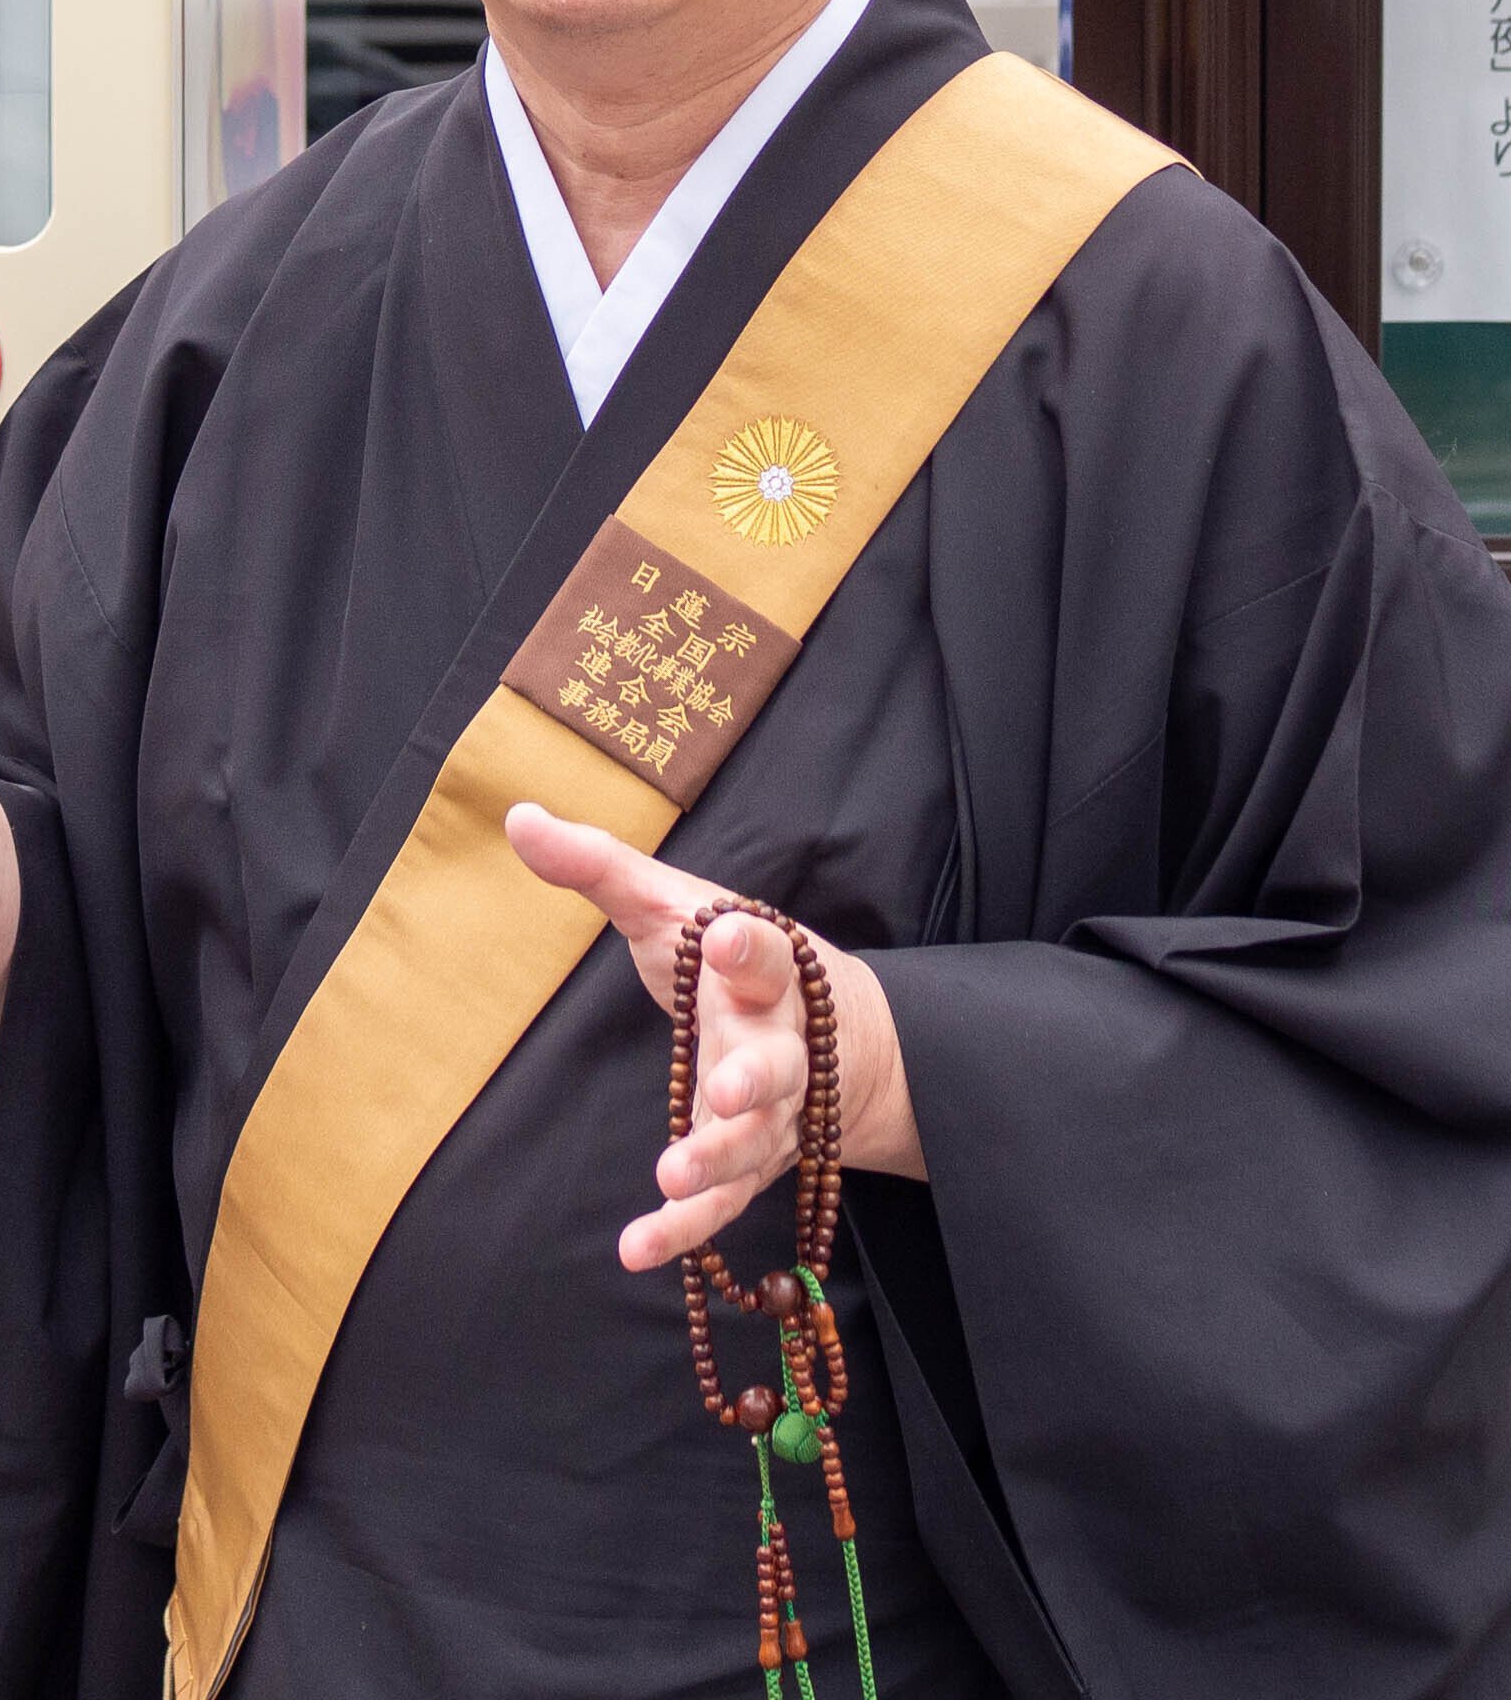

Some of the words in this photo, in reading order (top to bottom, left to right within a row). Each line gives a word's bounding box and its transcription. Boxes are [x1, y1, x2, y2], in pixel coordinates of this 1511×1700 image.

[630, 560, 759, 659] 日蓮宗
[638, 608, 718, 673] 全国
[575, 644, 694, 739] 連合会
[577, 603, 735, 728] 社会教化事業協会
